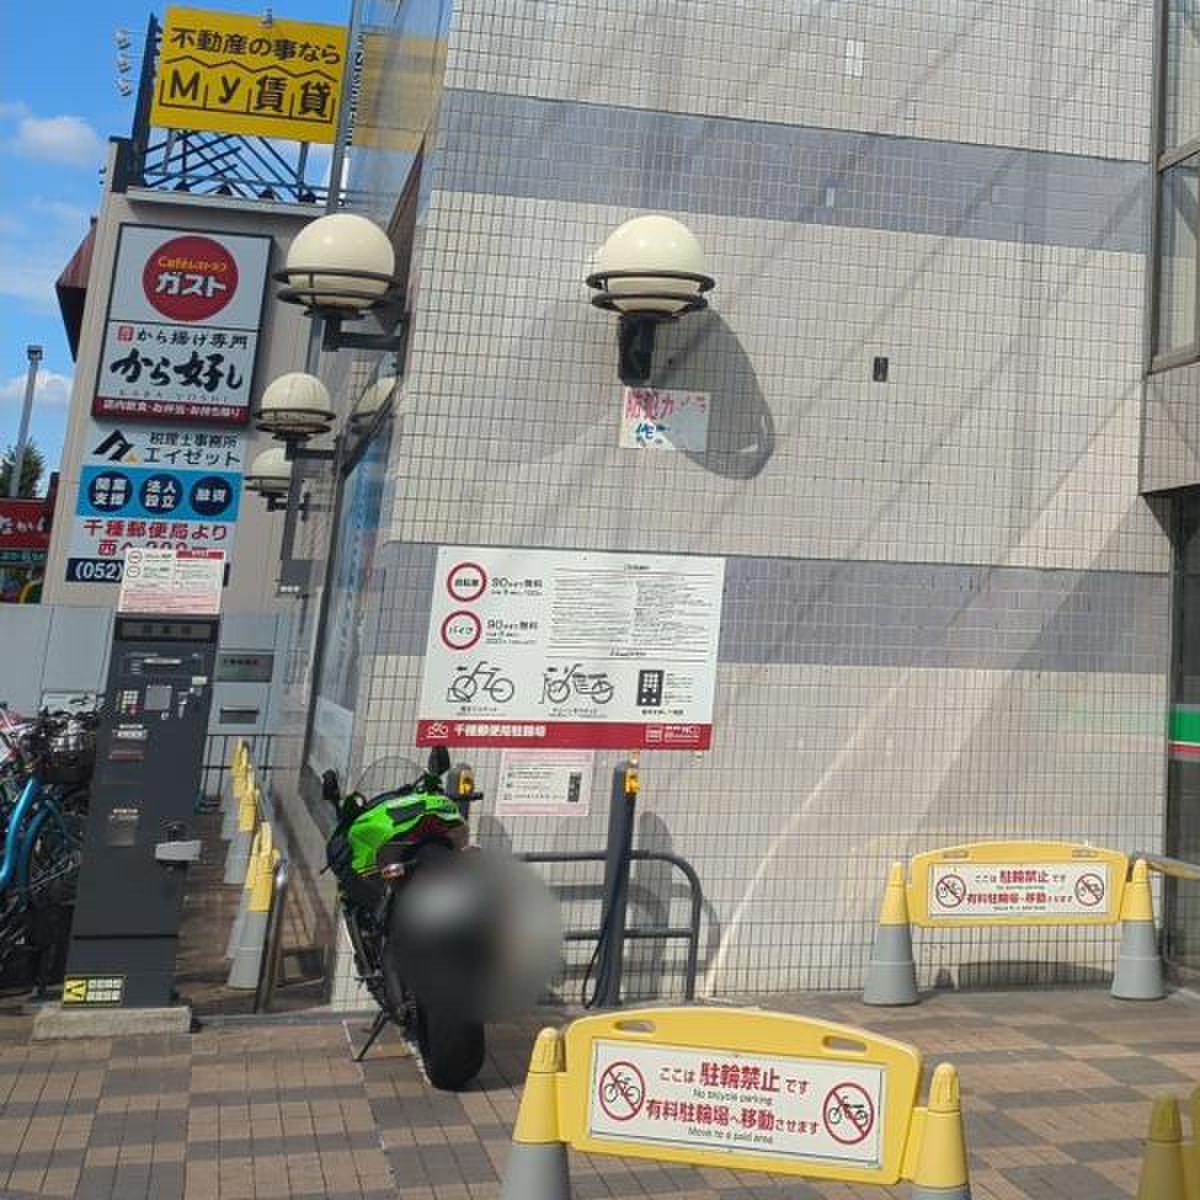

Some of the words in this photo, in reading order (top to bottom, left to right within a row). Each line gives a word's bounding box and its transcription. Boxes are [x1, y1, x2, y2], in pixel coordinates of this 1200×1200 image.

[171, 27, 341, 64] 不動産の事なら
[155, 272, 227, 297] ガスト
[110, 348, 243, 392] から好し
[144, 447, 241, 466] エイゼット
[83, 519, 228, 541] 千種郵便局より
